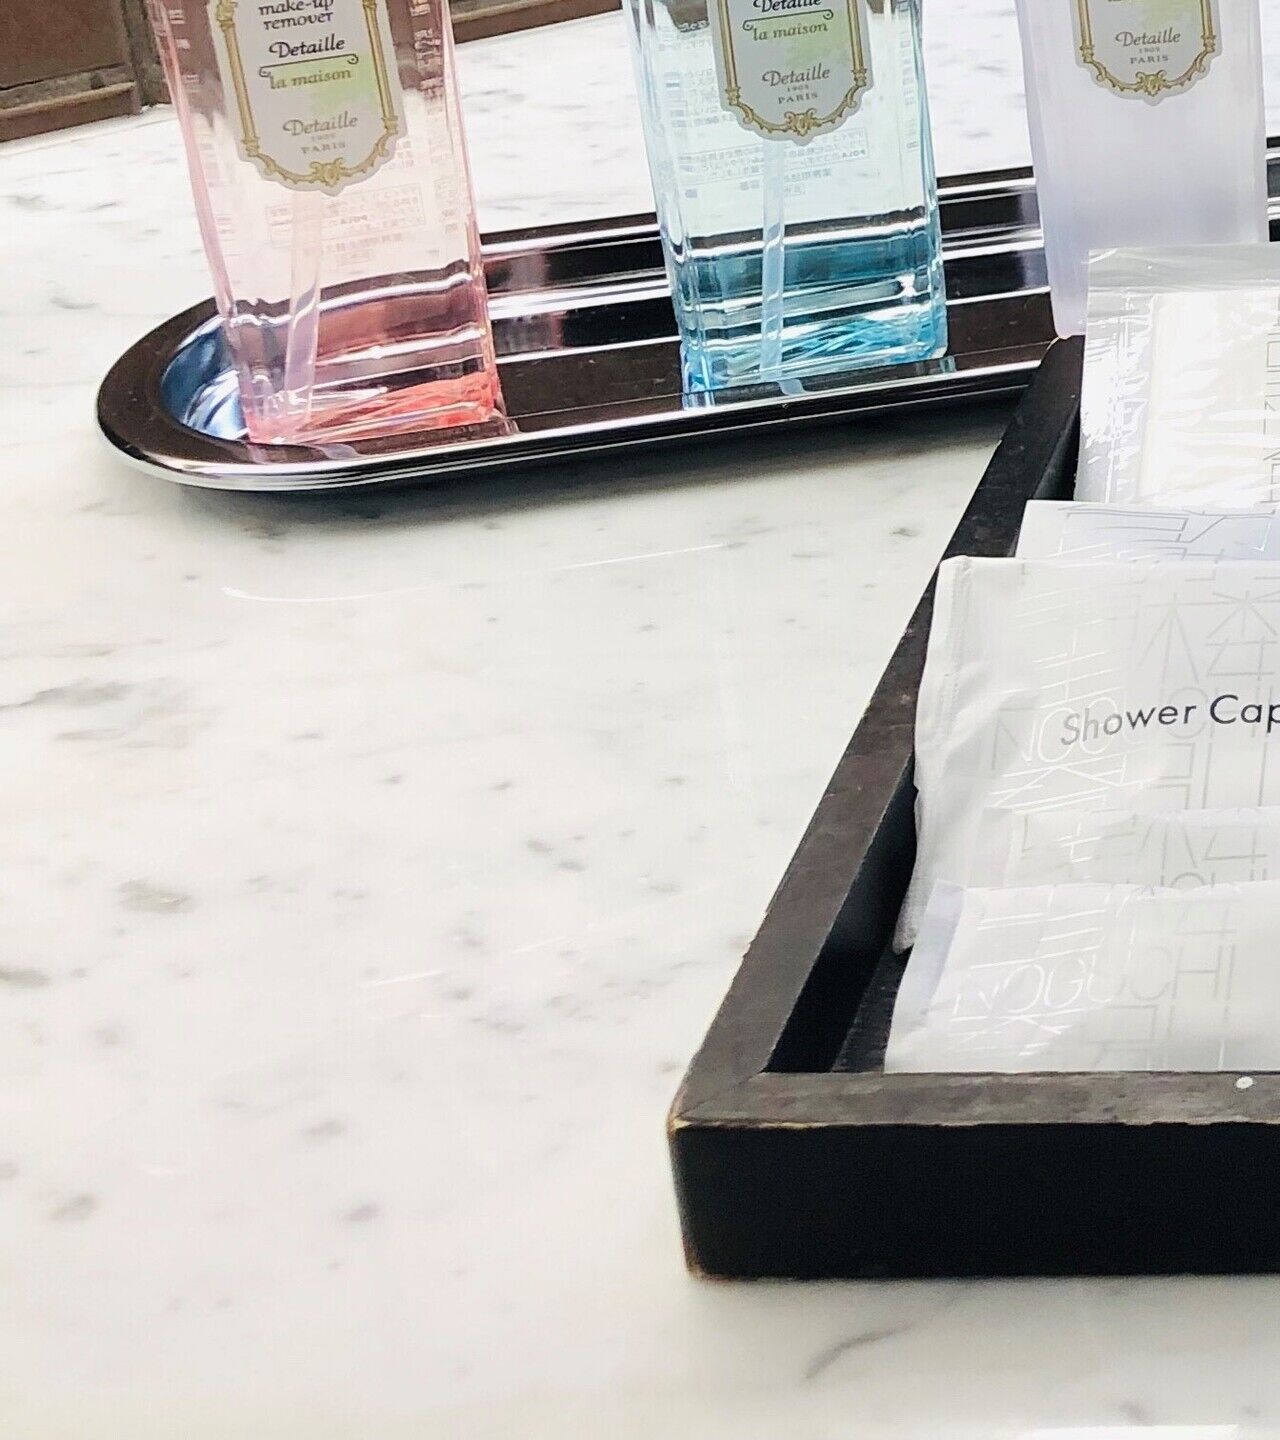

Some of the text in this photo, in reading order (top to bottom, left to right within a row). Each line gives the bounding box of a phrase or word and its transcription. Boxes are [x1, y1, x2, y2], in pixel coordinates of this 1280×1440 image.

[263, 11, 333, 30] remover
[753, 22, 829, 41] la maison
[1115, 27, 1181, 47] Detaille
[269, 34, 345, 58] Detaille
[1130, 54, 1168, 65] PARIS
[270, 68, 352, 90] la maison
[762, 63, 830, 87] Detaille
[778, 92, 818, 104] PARIS
[283, 111, 358, 136] Detaille
[301, 141, 346, 154] PARIS
[1061, 700, 1197, 747] Shower
